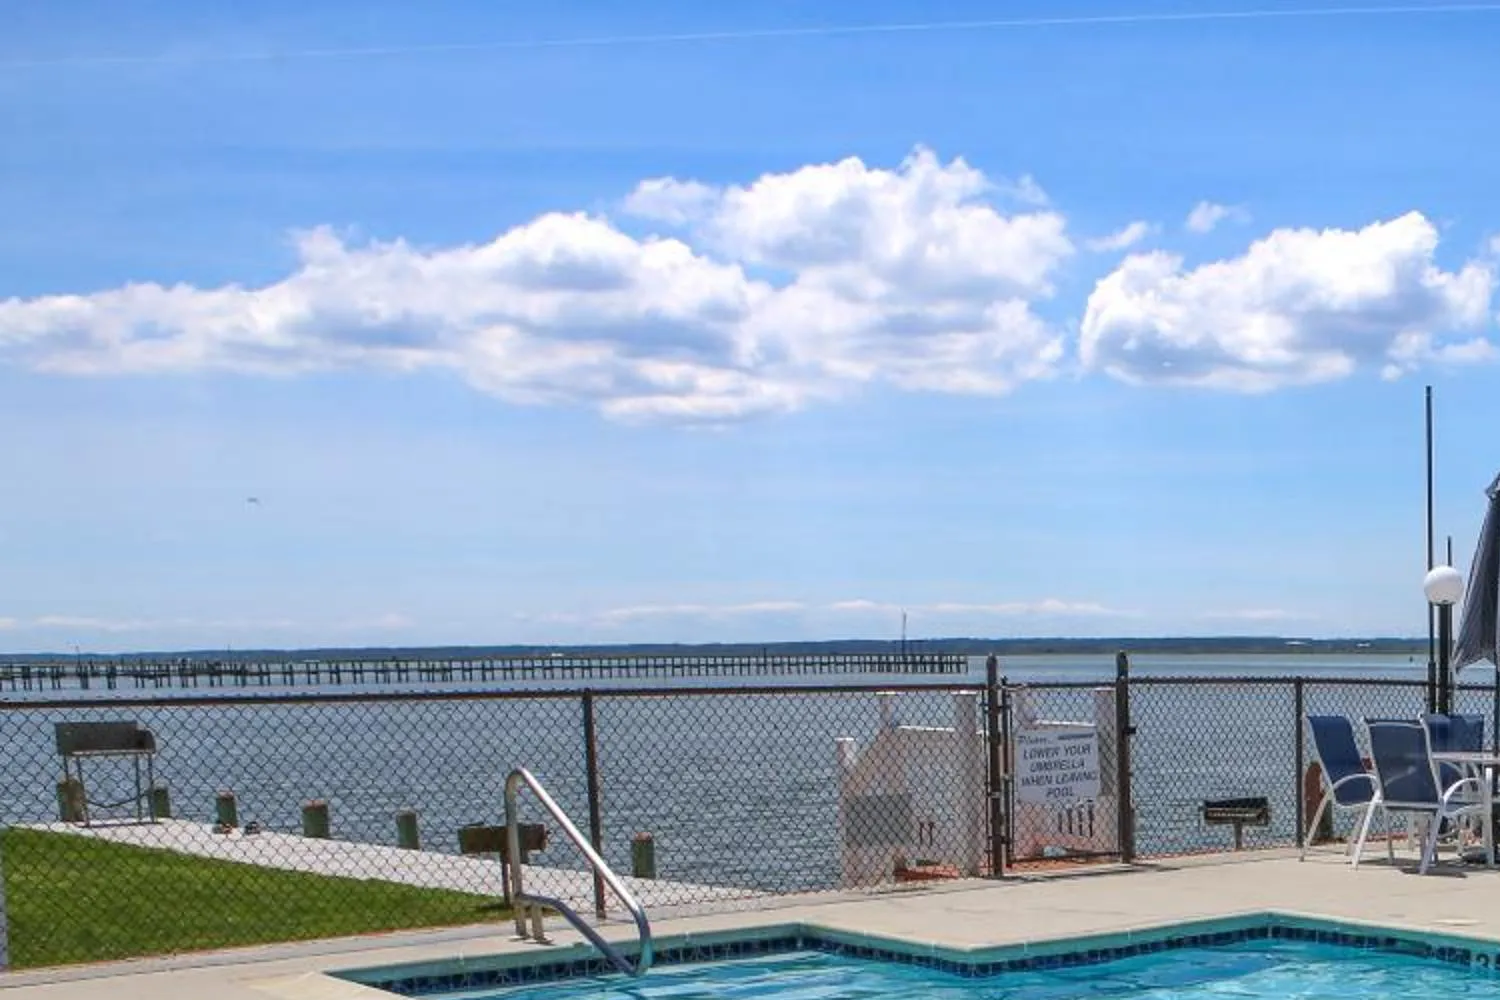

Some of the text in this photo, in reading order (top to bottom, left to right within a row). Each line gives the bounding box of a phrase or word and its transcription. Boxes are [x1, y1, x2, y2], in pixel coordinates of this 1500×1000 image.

[1023, 743, 1091, 760] LOWER YOUR
[1030, 759, 1085, 772] UMBRELLA
[1021, 770, 1097, 786] WHEN LEAVING
[1046, 786, 1074, 798] POOL
